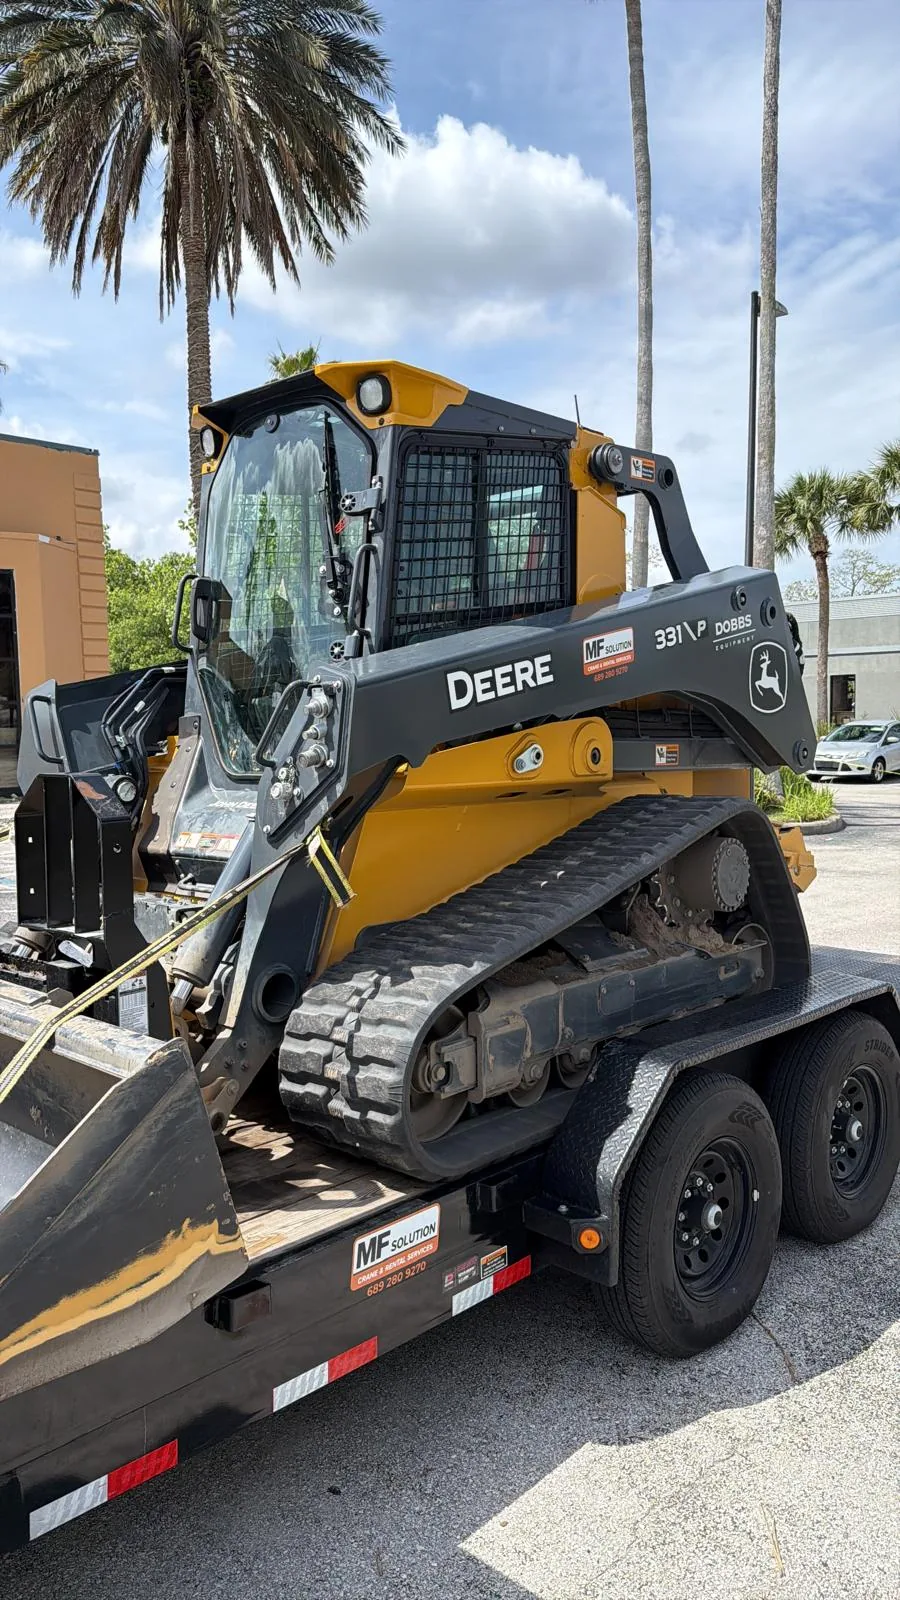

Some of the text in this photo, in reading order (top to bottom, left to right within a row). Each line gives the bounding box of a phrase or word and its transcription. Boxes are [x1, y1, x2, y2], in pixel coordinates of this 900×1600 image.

[715, 614, 752, 636] DOBBS
[585, 638, 632, 660] MF SOLUTION
[715, 635, 754, 651] EQUIPMENT
[446, 654, 554, 710] DEERE
[356, 1221, 436, 1269] MF SOLUTION
[357, 1270, 378, 1284] CRANE
[385, 1256, 406, 1270] RENTAL
[407, 1244, 433, 1260] SERVICES
[367, 1261, 427, 1296] 689 280 9270
